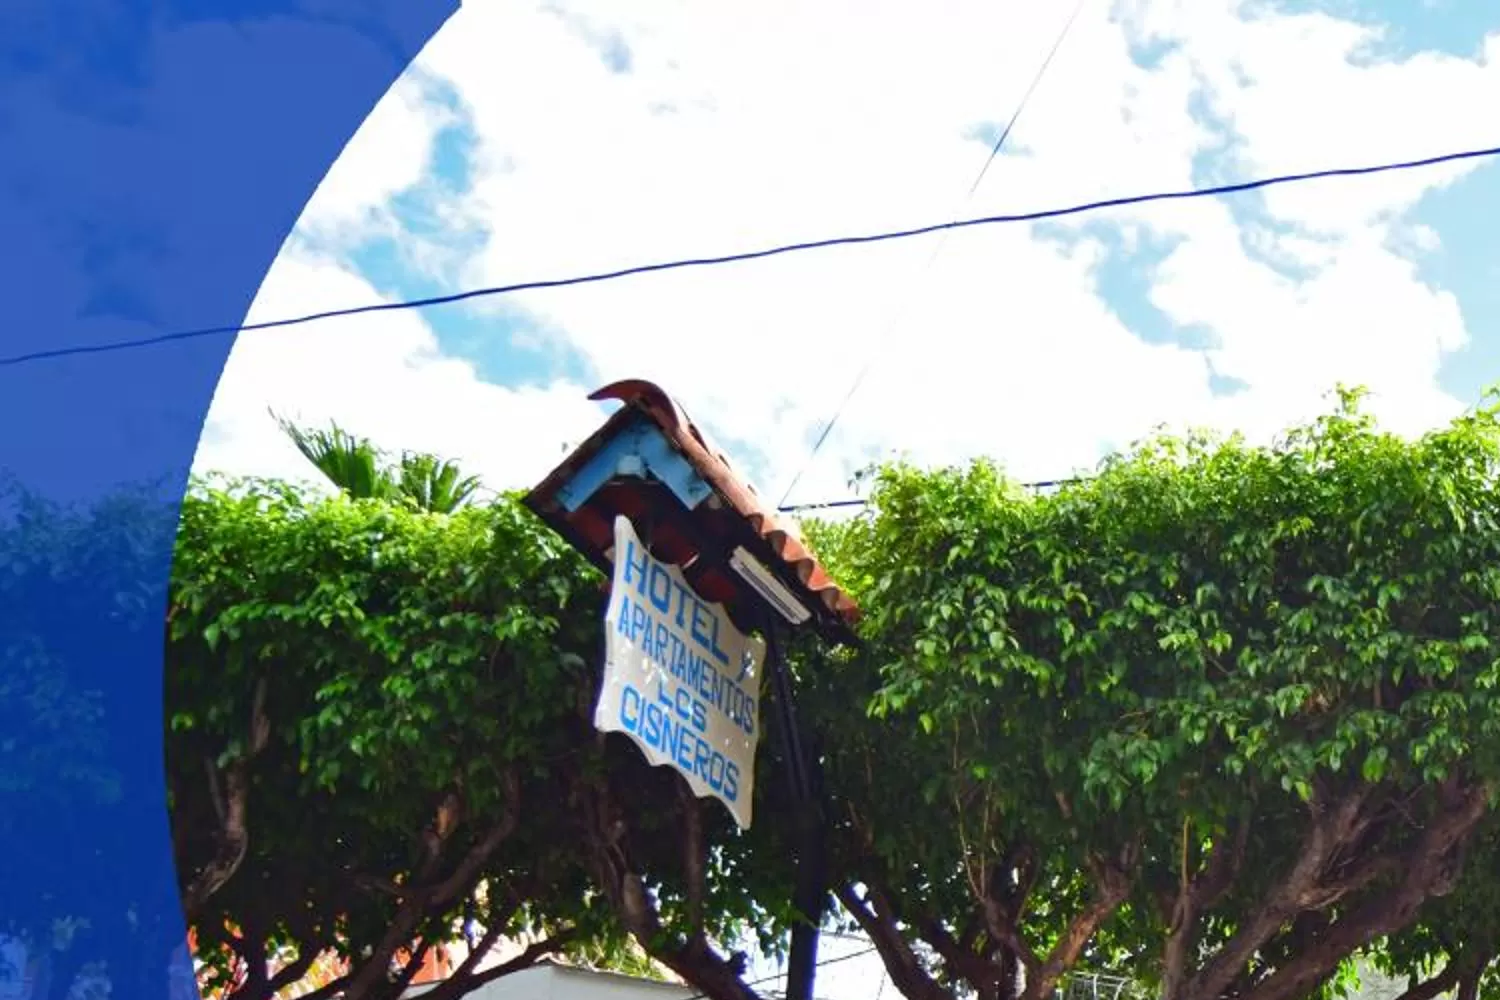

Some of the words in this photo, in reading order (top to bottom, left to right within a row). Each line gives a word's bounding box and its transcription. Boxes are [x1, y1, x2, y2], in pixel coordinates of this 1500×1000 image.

[624, 541, 730, 664] HOTEL
[618, 595, 754, 736] APARTAMENTOS
[621, 684, 739, 801] CISNEROS
